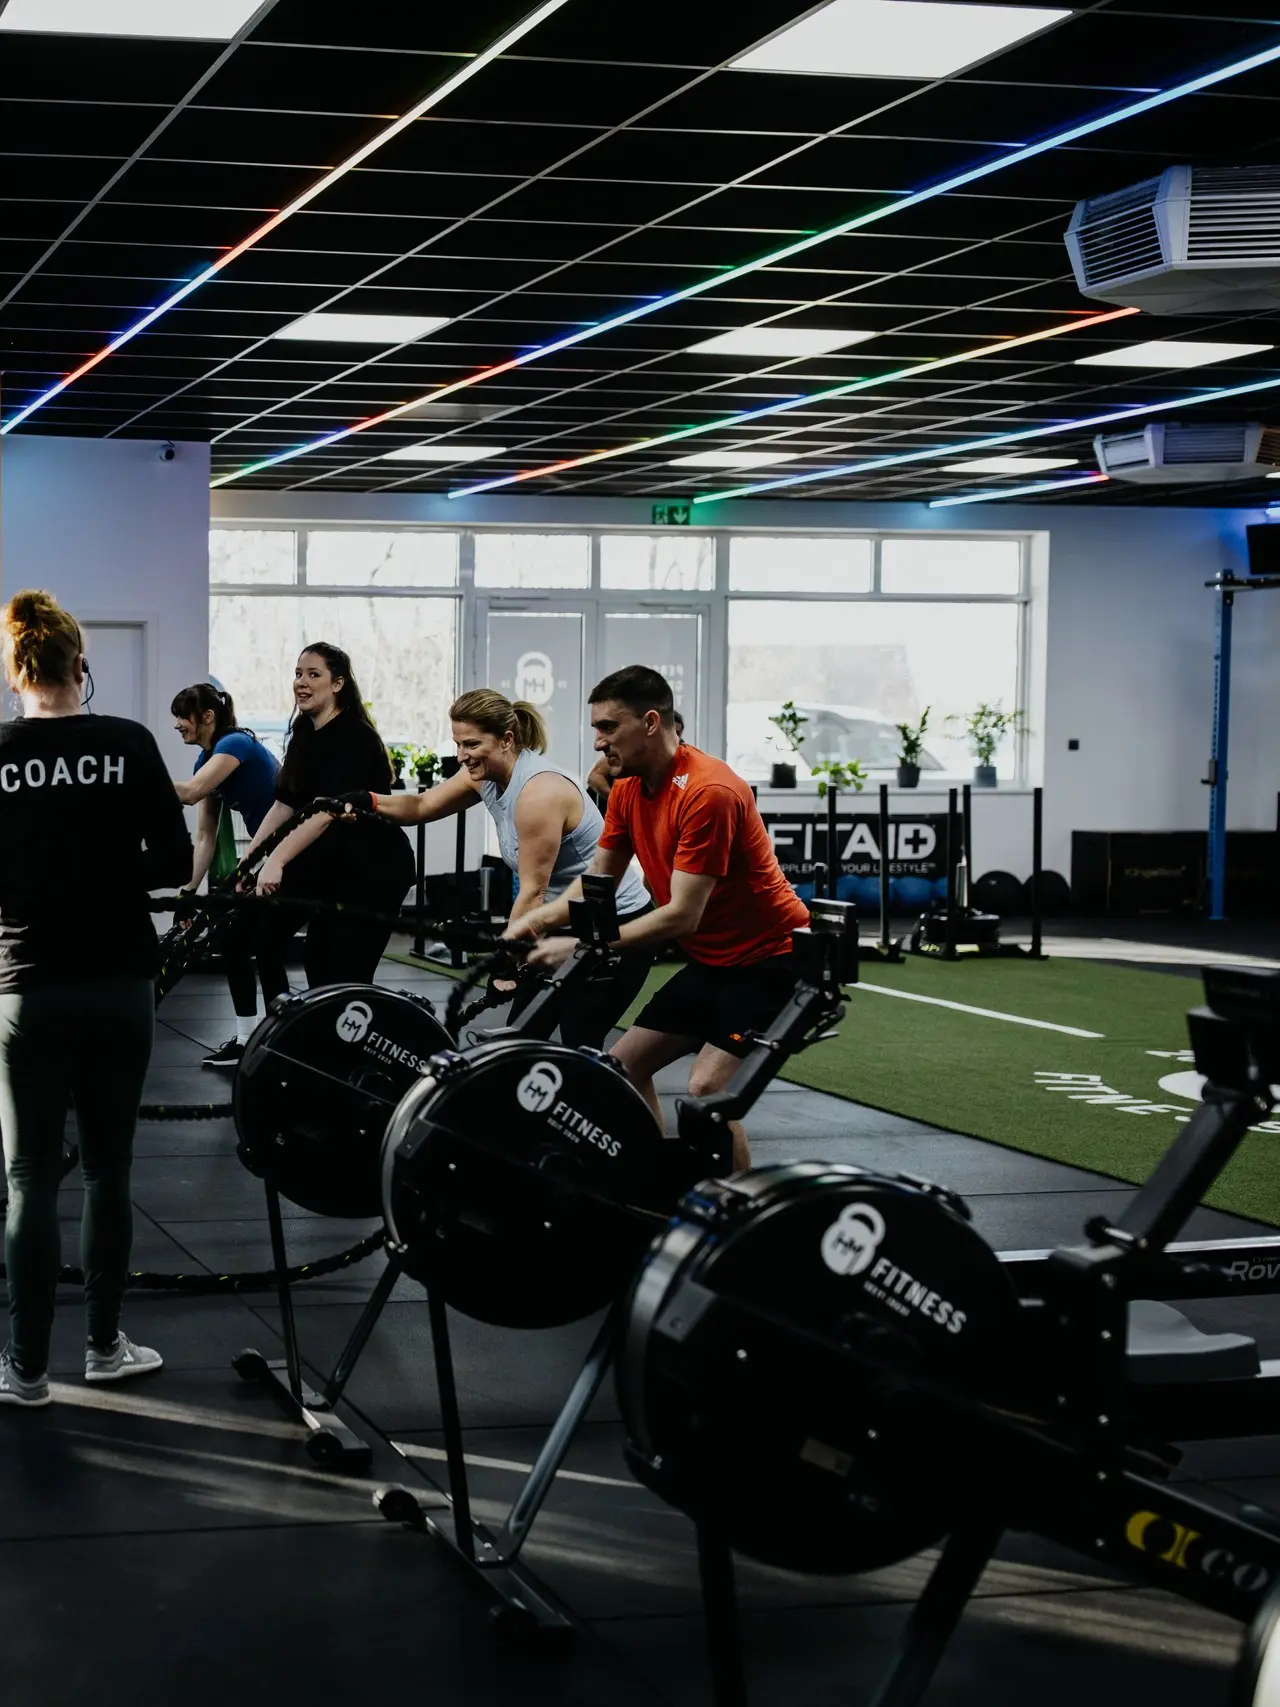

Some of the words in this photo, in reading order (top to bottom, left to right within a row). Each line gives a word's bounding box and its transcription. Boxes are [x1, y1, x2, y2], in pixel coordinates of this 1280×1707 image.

[0, 754, 125, 793] COACH
[841, 863, 870, 874] YOUR
[367, 1031, 426, 1074] FITNESS
[552, 1100, 622, 1158] FITNESS
[870, 1256, 968, 1335] FITNESS
